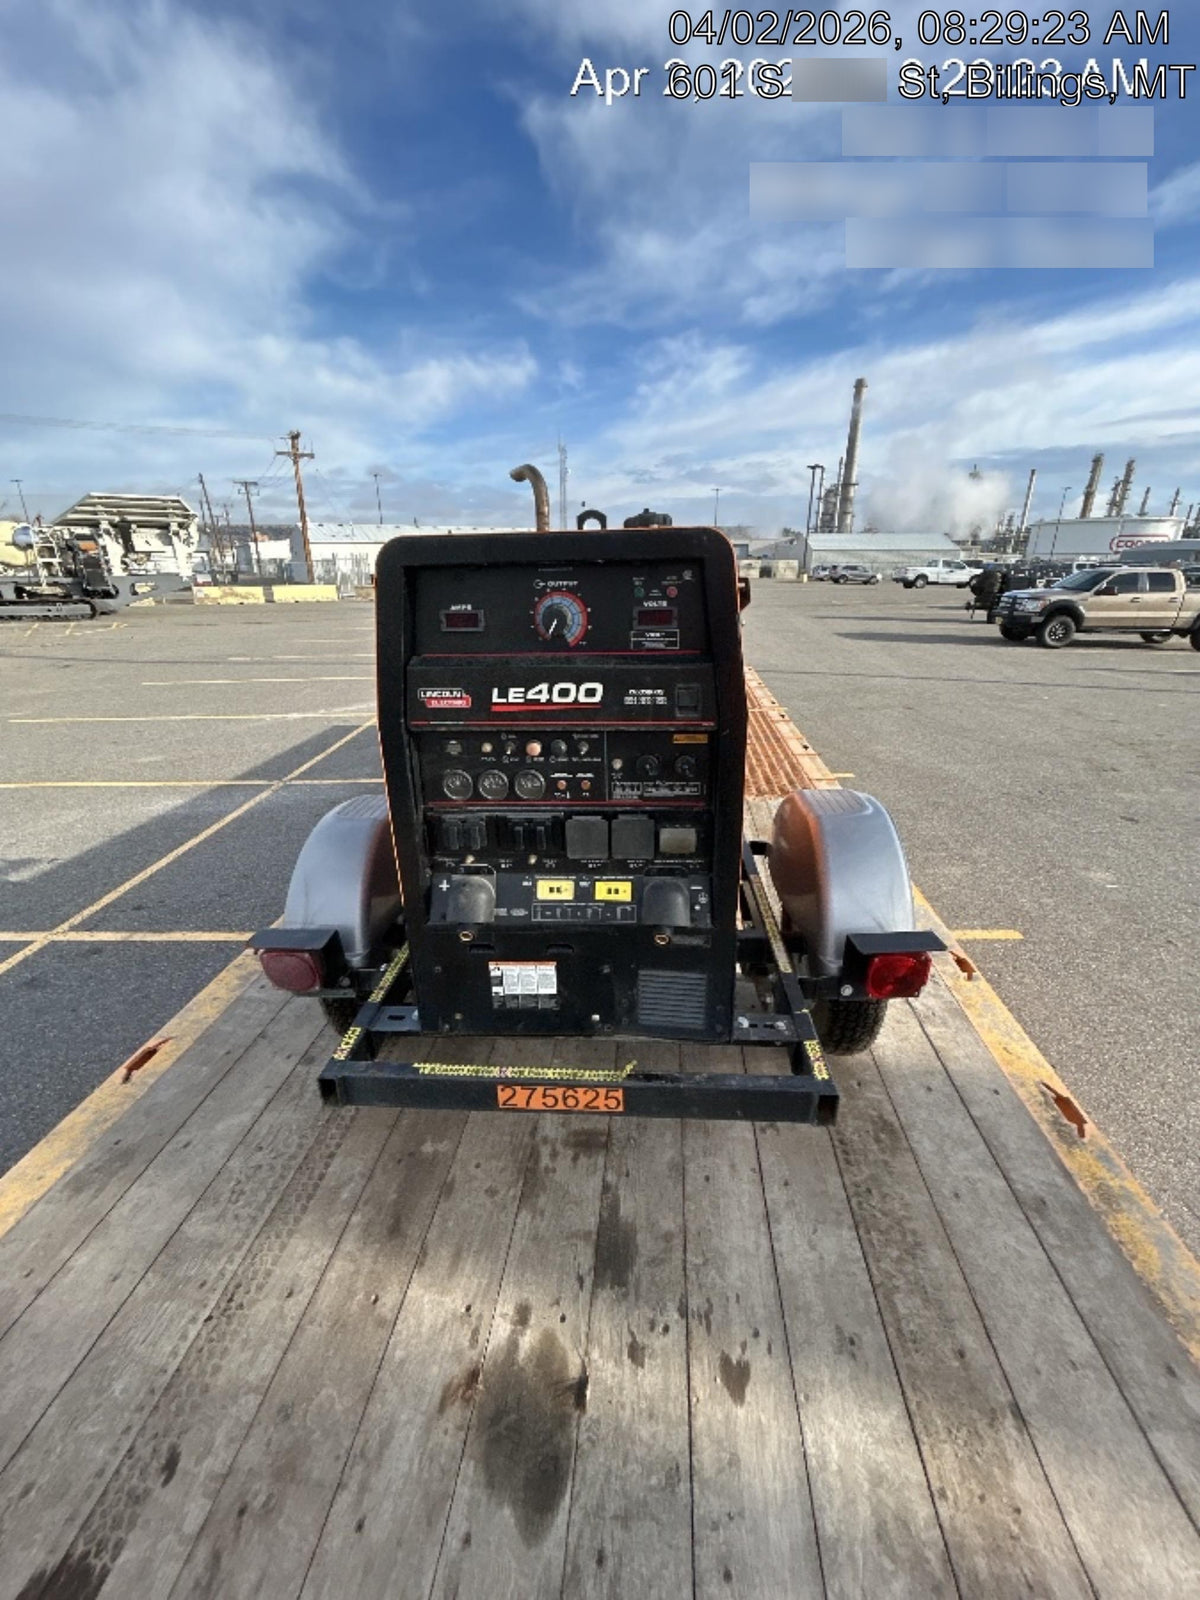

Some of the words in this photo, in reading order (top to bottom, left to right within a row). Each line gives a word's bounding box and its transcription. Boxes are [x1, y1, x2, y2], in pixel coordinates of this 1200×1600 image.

[420, 690, 462, 698] LINCOLN
[491, 682, 603, 703] LE400
[500, 1086, 622, 1110] 275625
